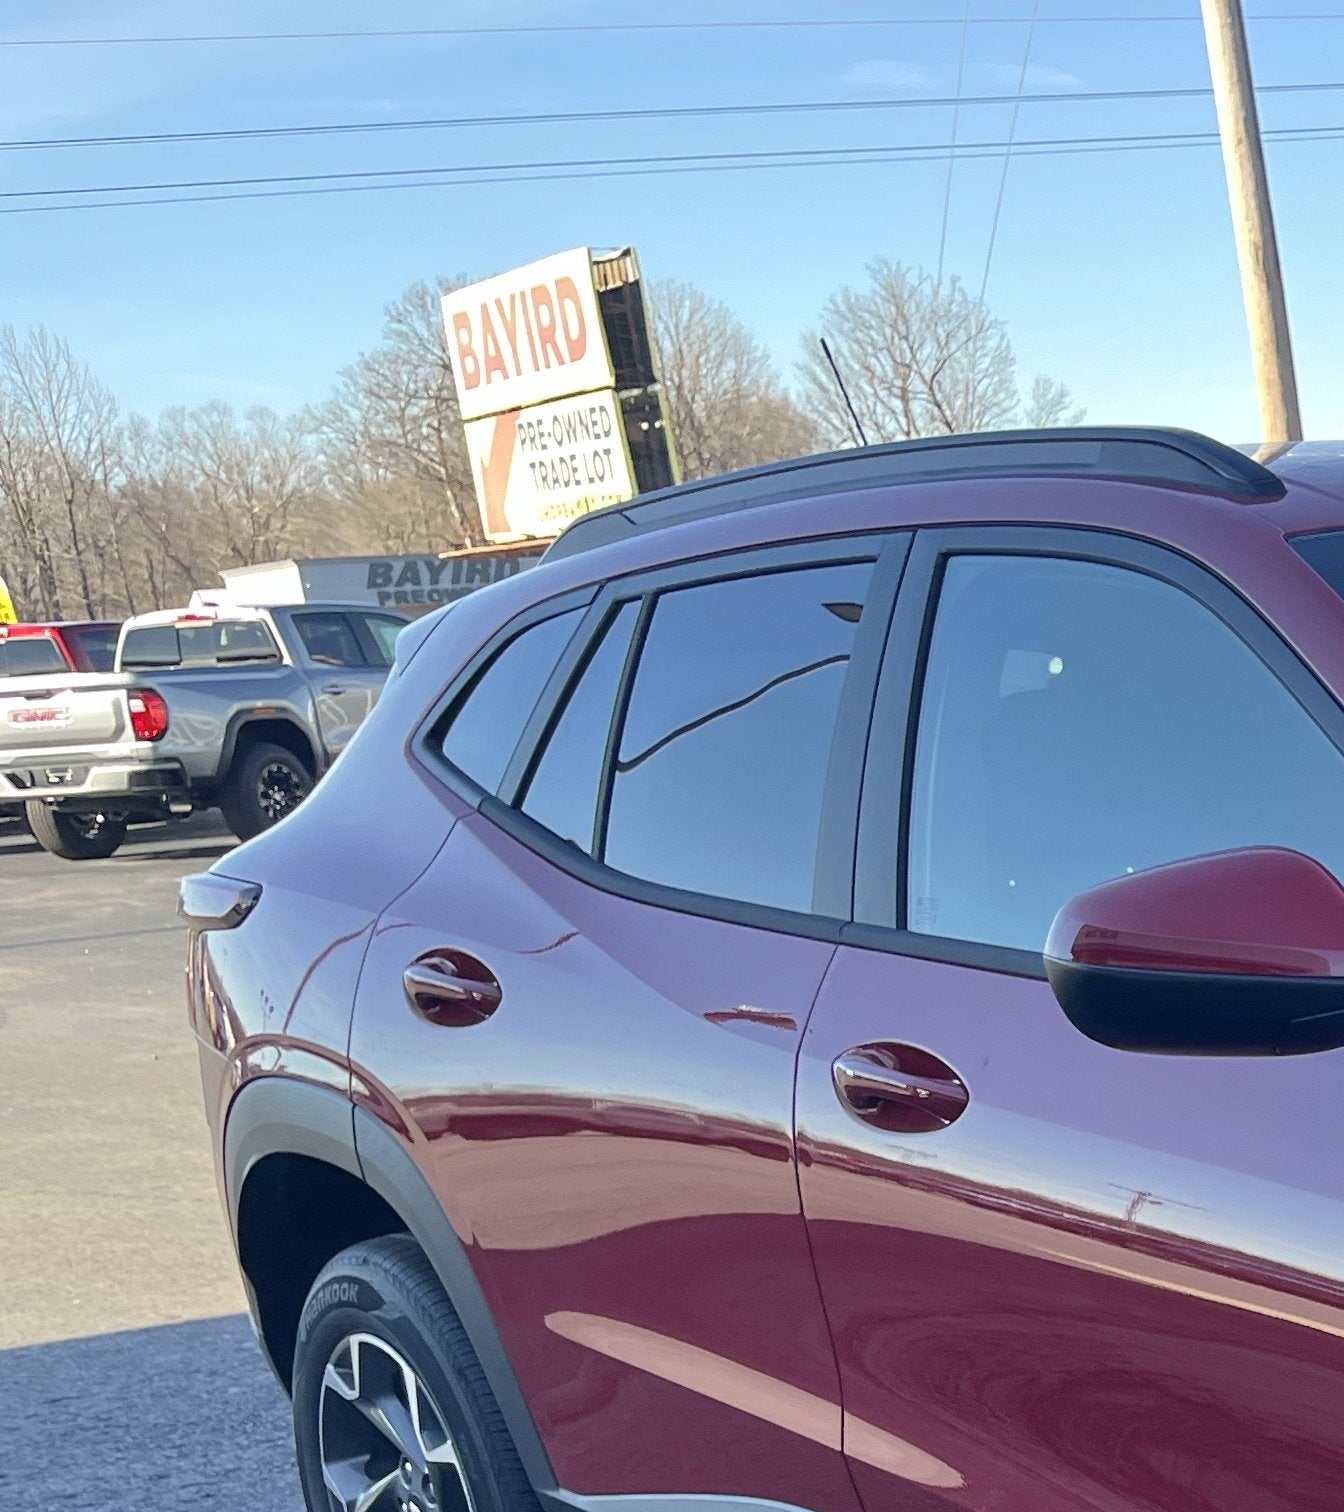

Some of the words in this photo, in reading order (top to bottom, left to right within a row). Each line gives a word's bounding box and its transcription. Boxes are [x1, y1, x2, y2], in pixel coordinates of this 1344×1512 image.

[452, 275, 588, 391] BAYIRD
[517, 405, 612, 453] PRE-OWNED
[529, 454, 580, 493] TRADE
[585, 448, 615, 486] LOT
